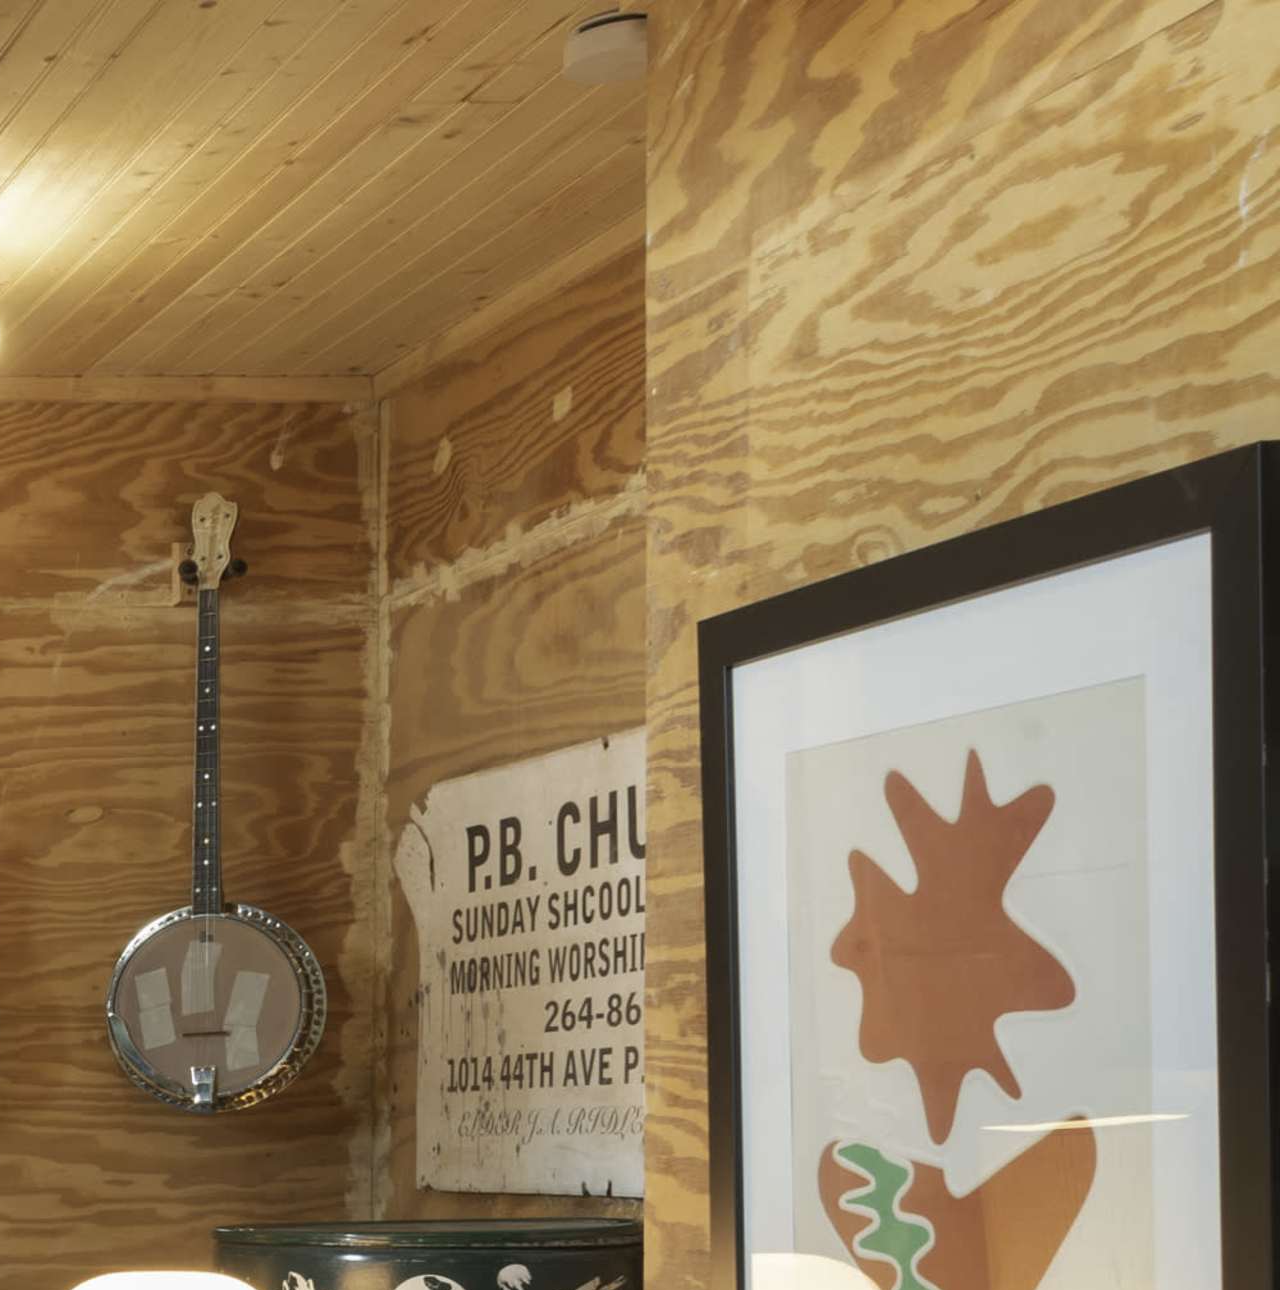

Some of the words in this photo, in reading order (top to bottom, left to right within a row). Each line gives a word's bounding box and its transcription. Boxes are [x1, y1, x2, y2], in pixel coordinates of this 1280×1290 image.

[466, 816, 537, 893] P.B.
[557, 785, 646, 876] CHU
[452, 894, 540, 945] SUNDAY
[548, 876, 645, 931] SHCOOL
[450, 948, 540, 995] MORNING
[544, 992, 641, 1033] 264-86
[447, 1055, 495, 1093] 1014
[500, 1050, 554, 1090] 44TH
[563, 1047, 613, 1087] AVE
